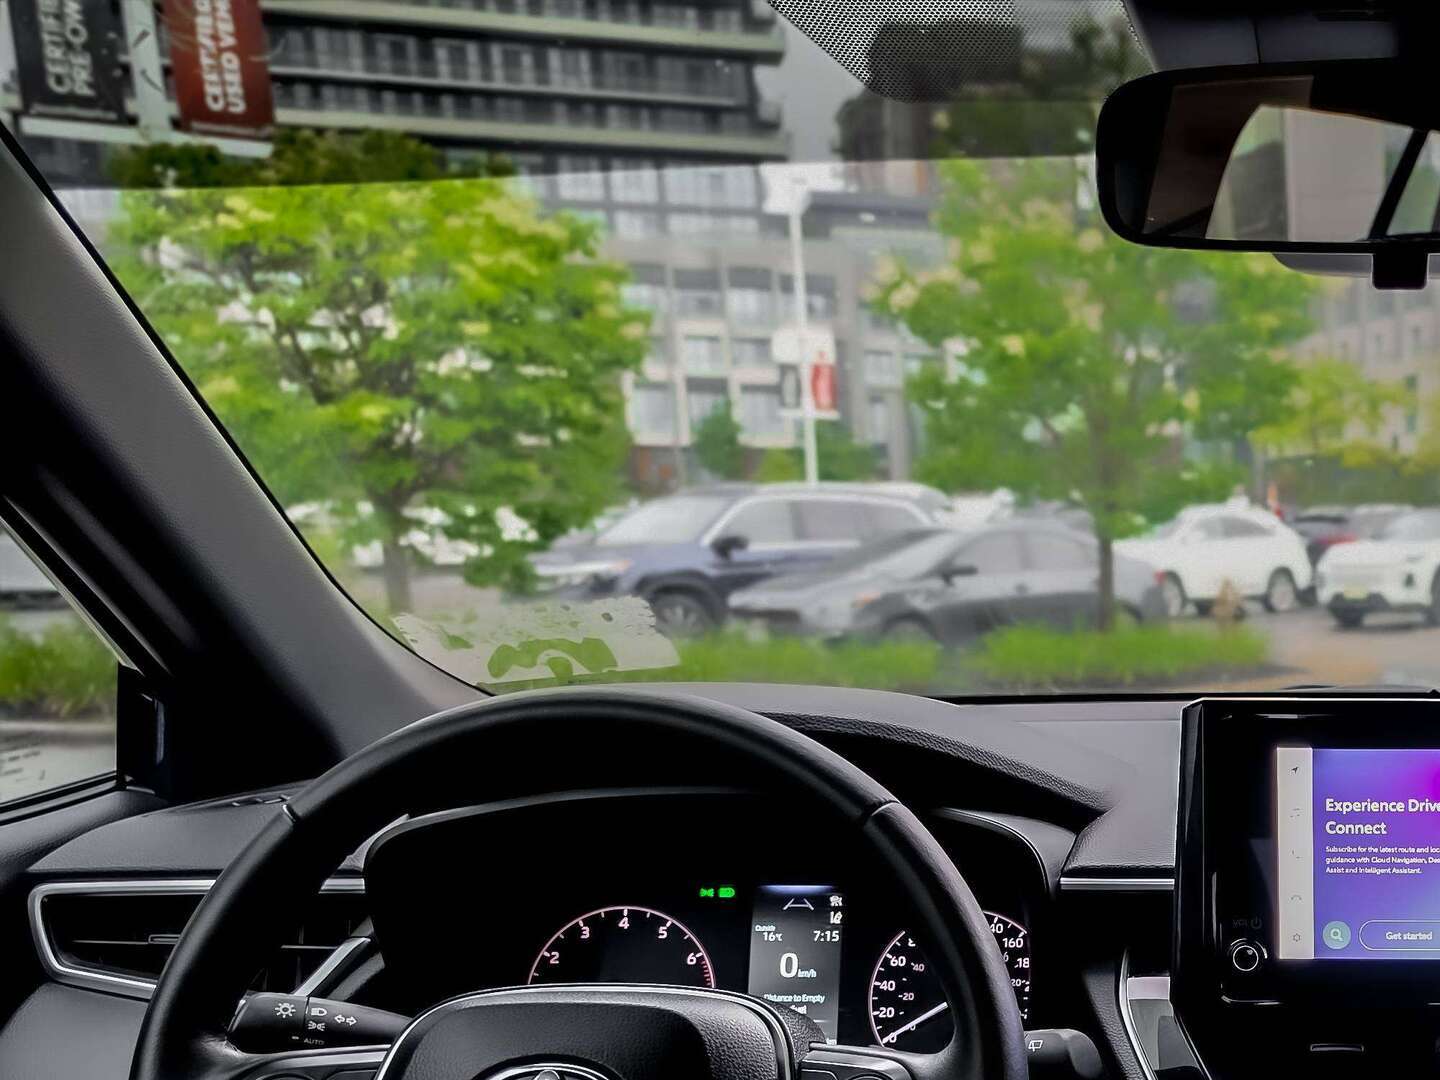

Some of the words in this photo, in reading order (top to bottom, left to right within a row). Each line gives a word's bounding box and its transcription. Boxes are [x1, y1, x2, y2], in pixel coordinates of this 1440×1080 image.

[1325, 798, 1405, 814] Experience
[1325, 821, 1388, 835] Connect
[1326, 846, 1357, 854] Subscribe
[1358, 846, 1367, 854] for
[1368, 846, 1379, 854] the
[1379, 846, 1397, 854] latest
[1398, 846, 1415, 854] route
[1416, 846, 1429, 854] and
[1326, 856, 1355, 865] guidance
[1356, 856, 1370, 864] with
[1371, 856, 1390, 864] Cloud
[1359, 867, 1391, 876] Intelligent
[618, 917, 630, 930] 4
[989, 923, 1004, 934] 40
[580, 926, 590, 939] 3
[657, 926, 668, 939] 5
[813, 930, 840, 942] 7:15
[1386, 931, 1402, 940] Get
[1403, 931, 1433, 940] started
[1002, 937, 1024, 948] 160
[549, 952, 560, 965] 2
[686, 952, 697, 965] 6
[890, 956, 906, 967] 60
[779, 952, 799, 978] 0
[798, 968, 817, 978] km/h
[913, 963, 925, 972] 40
[880, 980, 896, 991] 40
[793, 994, 801, 1002] to
[802, 994, 825, 1003] Empty
[902, 993, 914, 1001] 20
[879, 1007, 895, 1018] 20
